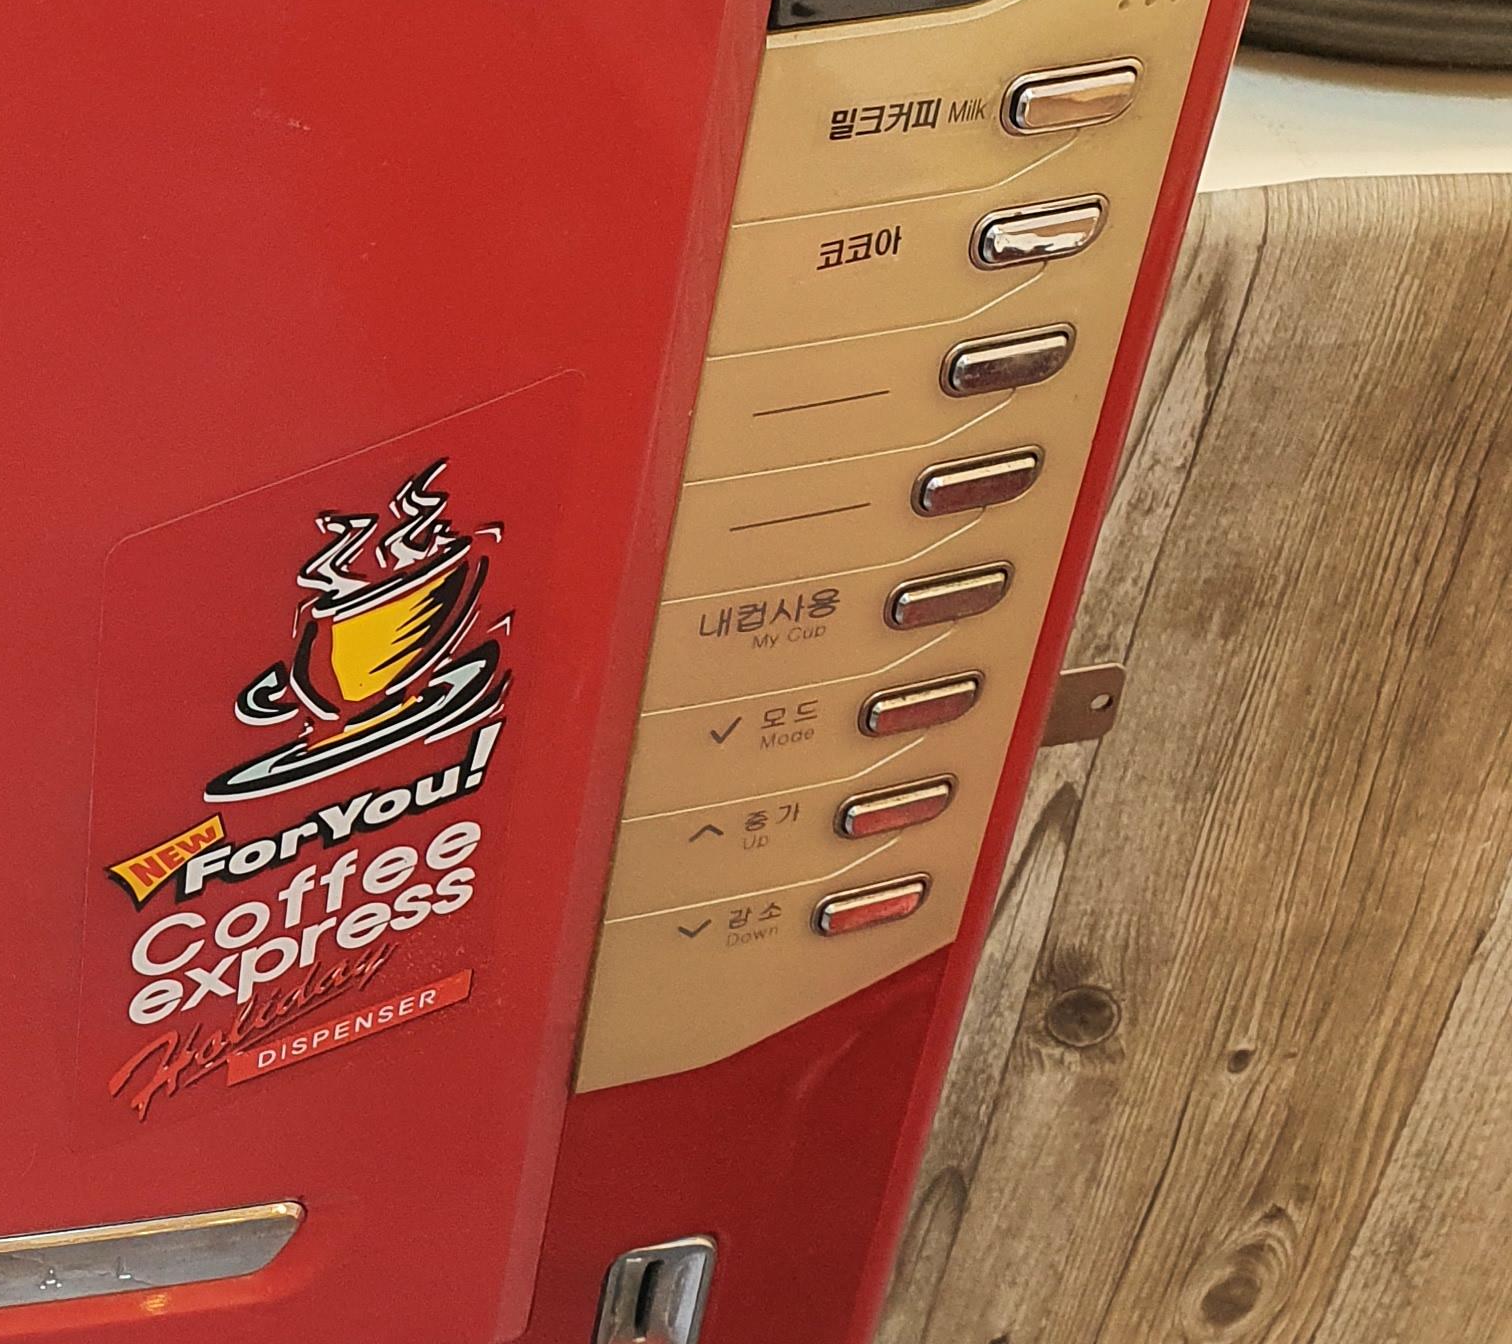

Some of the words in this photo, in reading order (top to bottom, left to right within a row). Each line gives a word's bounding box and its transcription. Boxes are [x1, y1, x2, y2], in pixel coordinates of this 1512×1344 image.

[829, 97, 942, 140] 밀크커피
[947, 98, 988, 123] Milk
[816, 225, 902, 270] 코코아
[699, 588, 841, 637] 내컵사용
[751, 633, 779, 649] My
[759, 727, 815, 750] Mode
[128, 823, 218, 888] NEW
[130, 820, 482, 977] Coffee
[127, 867, 477, 1025] express
[725, 925, 779, 947] Down
[256, 989, 438, 1069] DISPENSER
